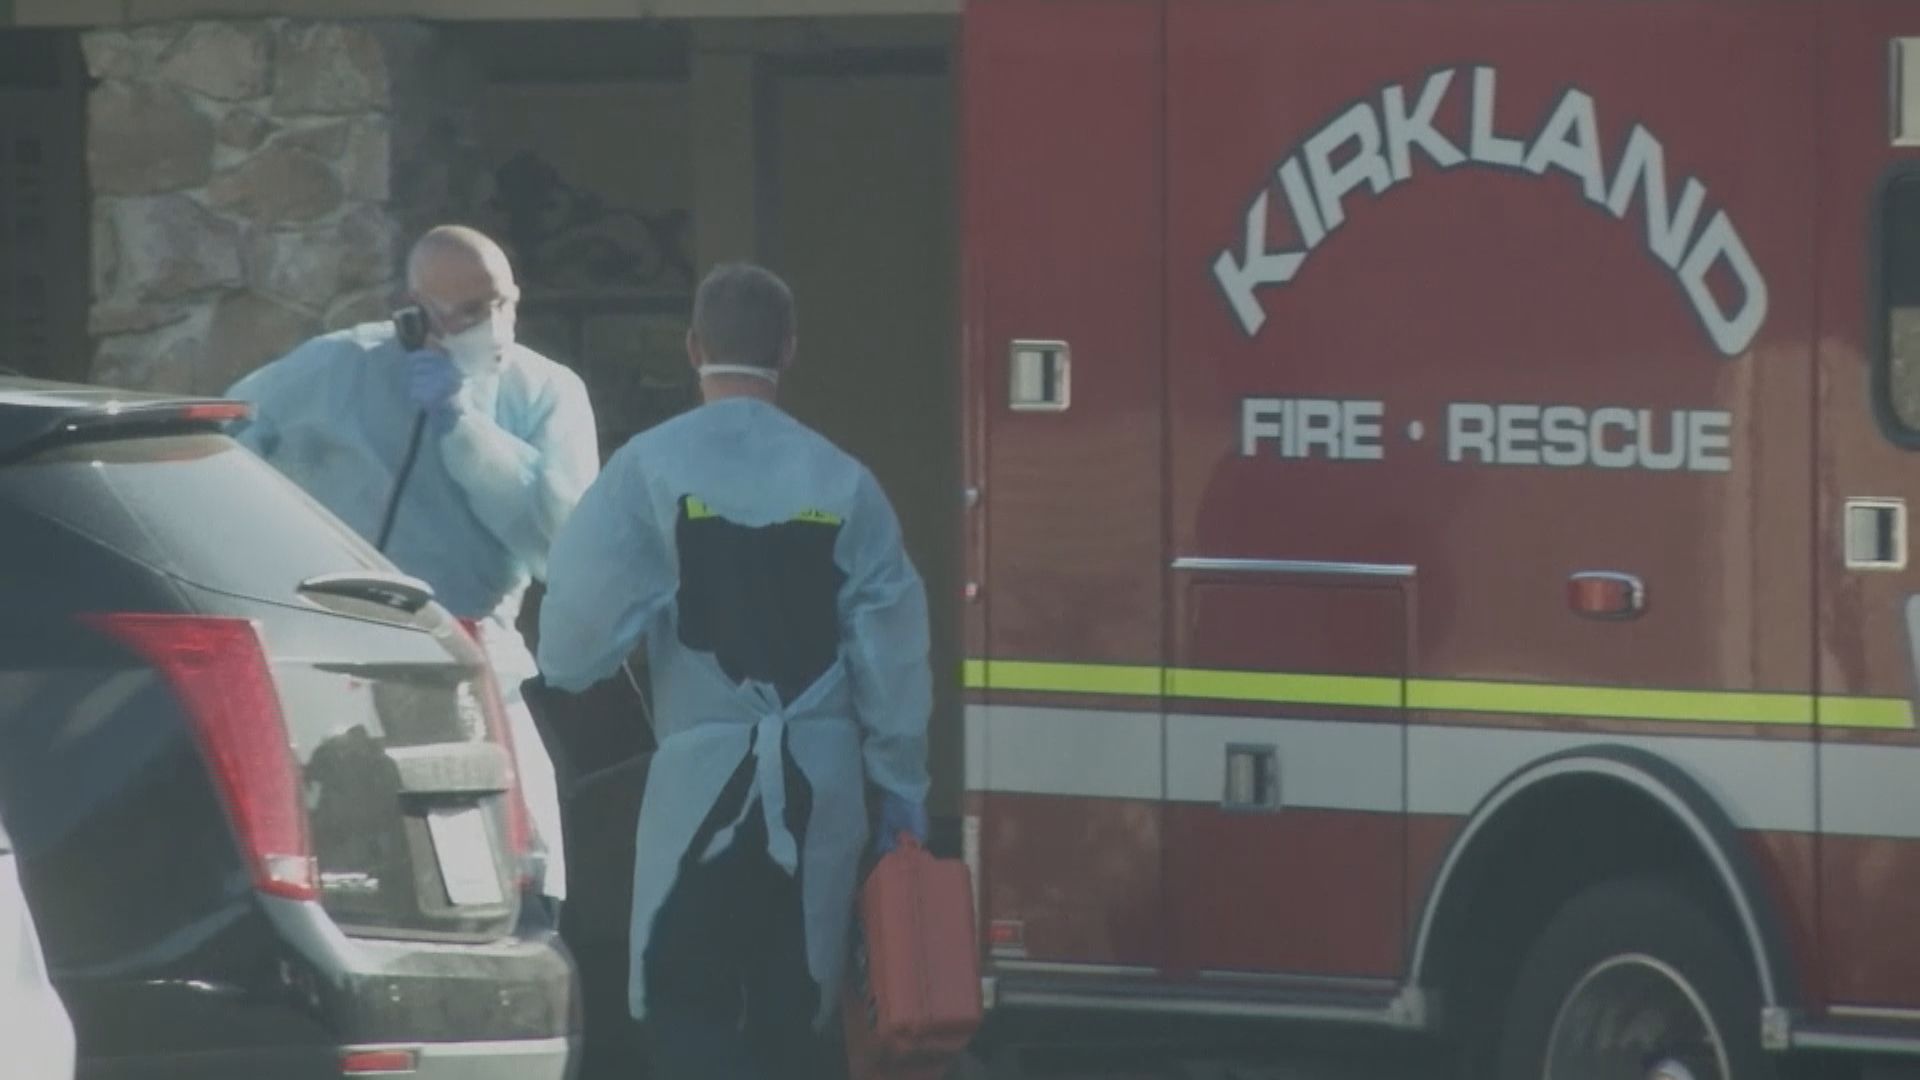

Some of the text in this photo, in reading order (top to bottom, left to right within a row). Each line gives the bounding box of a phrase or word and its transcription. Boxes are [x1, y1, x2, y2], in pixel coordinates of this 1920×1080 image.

[1213, 65, 1768, 356] KIRKLAND
[1242, 398, 1734, 472] FIRE RESCUE
